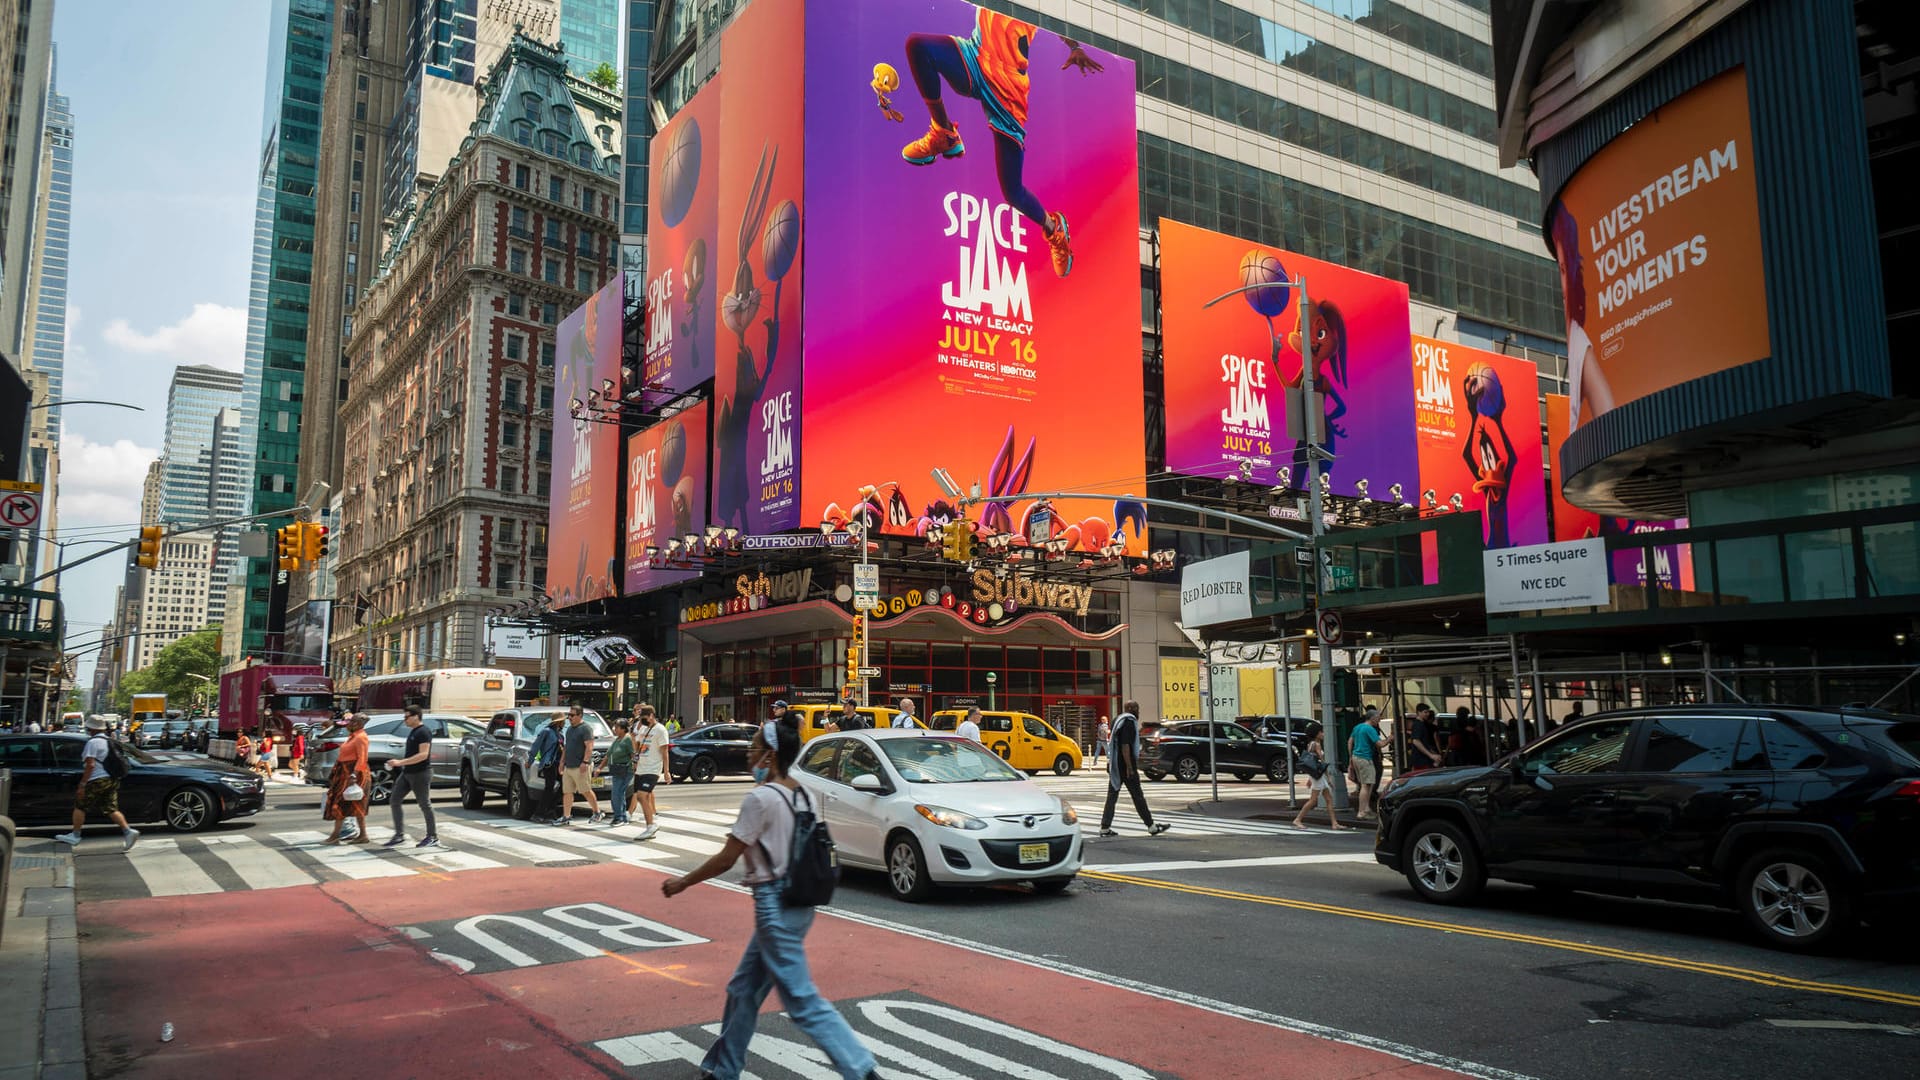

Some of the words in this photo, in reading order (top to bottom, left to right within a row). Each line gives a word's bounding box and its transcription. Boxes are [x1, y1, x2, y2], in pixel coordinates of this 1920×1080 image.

[1590, 140, 1738, 253] LIVESTREAM
[943, 191, 1028, 253] SPACE
[1594, 229, 1647, 283] YOUR
[648, 267, 672, 313] SPACE
[942, 245, 1033, 322] JAM
[1598, 234, 1707, 318] MOMENTS
[646, 303, 672, 355] JAM
[942, 309, 952, 321] A
[955, 311, 984, 326] NEW
[987, 319, 1034, 336] LEGACY
[938, 325, 1000, 356] JULY
[1010, 338, 1037, 363] 16
[1415, 342, 1449, 372] SPACE
[645, 359, 661, 380] JULY
[663, 352, 672, 369] 16
[938, 354, 949, 364] IN
[950, 355, 996, 372] THEATERS
[1221, 354, 1266, 389] SPACE
[1416, 370, 1453, 408] JAM
[762, 391, 792, 432] SPACE
[1221, 387, 1270, 430] JAM
[1418, 411, 1441, 425] JULY
[1444, 416, 1456, 428] 16
[1222, 435, 1253, 452] JULY
[1257, 441, 1272, 456] 16
[1229, 426, 1244, 434] NEW
[1245, 429, 1271, 439] LEGACY
[571, 438, 591, 480] JAM
[760, 426, 793, 475] JAM
[631, 448, 656, 488] SPACE
[765, 473, 776, 483] NEW
[776, 467, 793, 480] LEGACY
[760, 482, 781, 501] JULY
[783, 478, 793, 494] 16
[629, 483, 656, 533] JAM
[628, 540, 645, 560] JULY
[746, 535, 814, 548] OUTFRONT
[1497, 556, 1504, 567] 5
[1506, 550, 1542, 566] Times
[1544, 547, 1588, 564] Square
[972, 568, 1092, 616] Subway
[1182, 588, 1200, 606] RED
[1201, 581, 1242, 598] LOBSTER
[1521, 578, 1542, 590] NYC
[1545, 576, 1567, 588] EDC
[1222, 641, 1277, 661] LOF
[1164, 682, 1195, 692] LOVE
[1212, 666, 1234, 676] OFT
